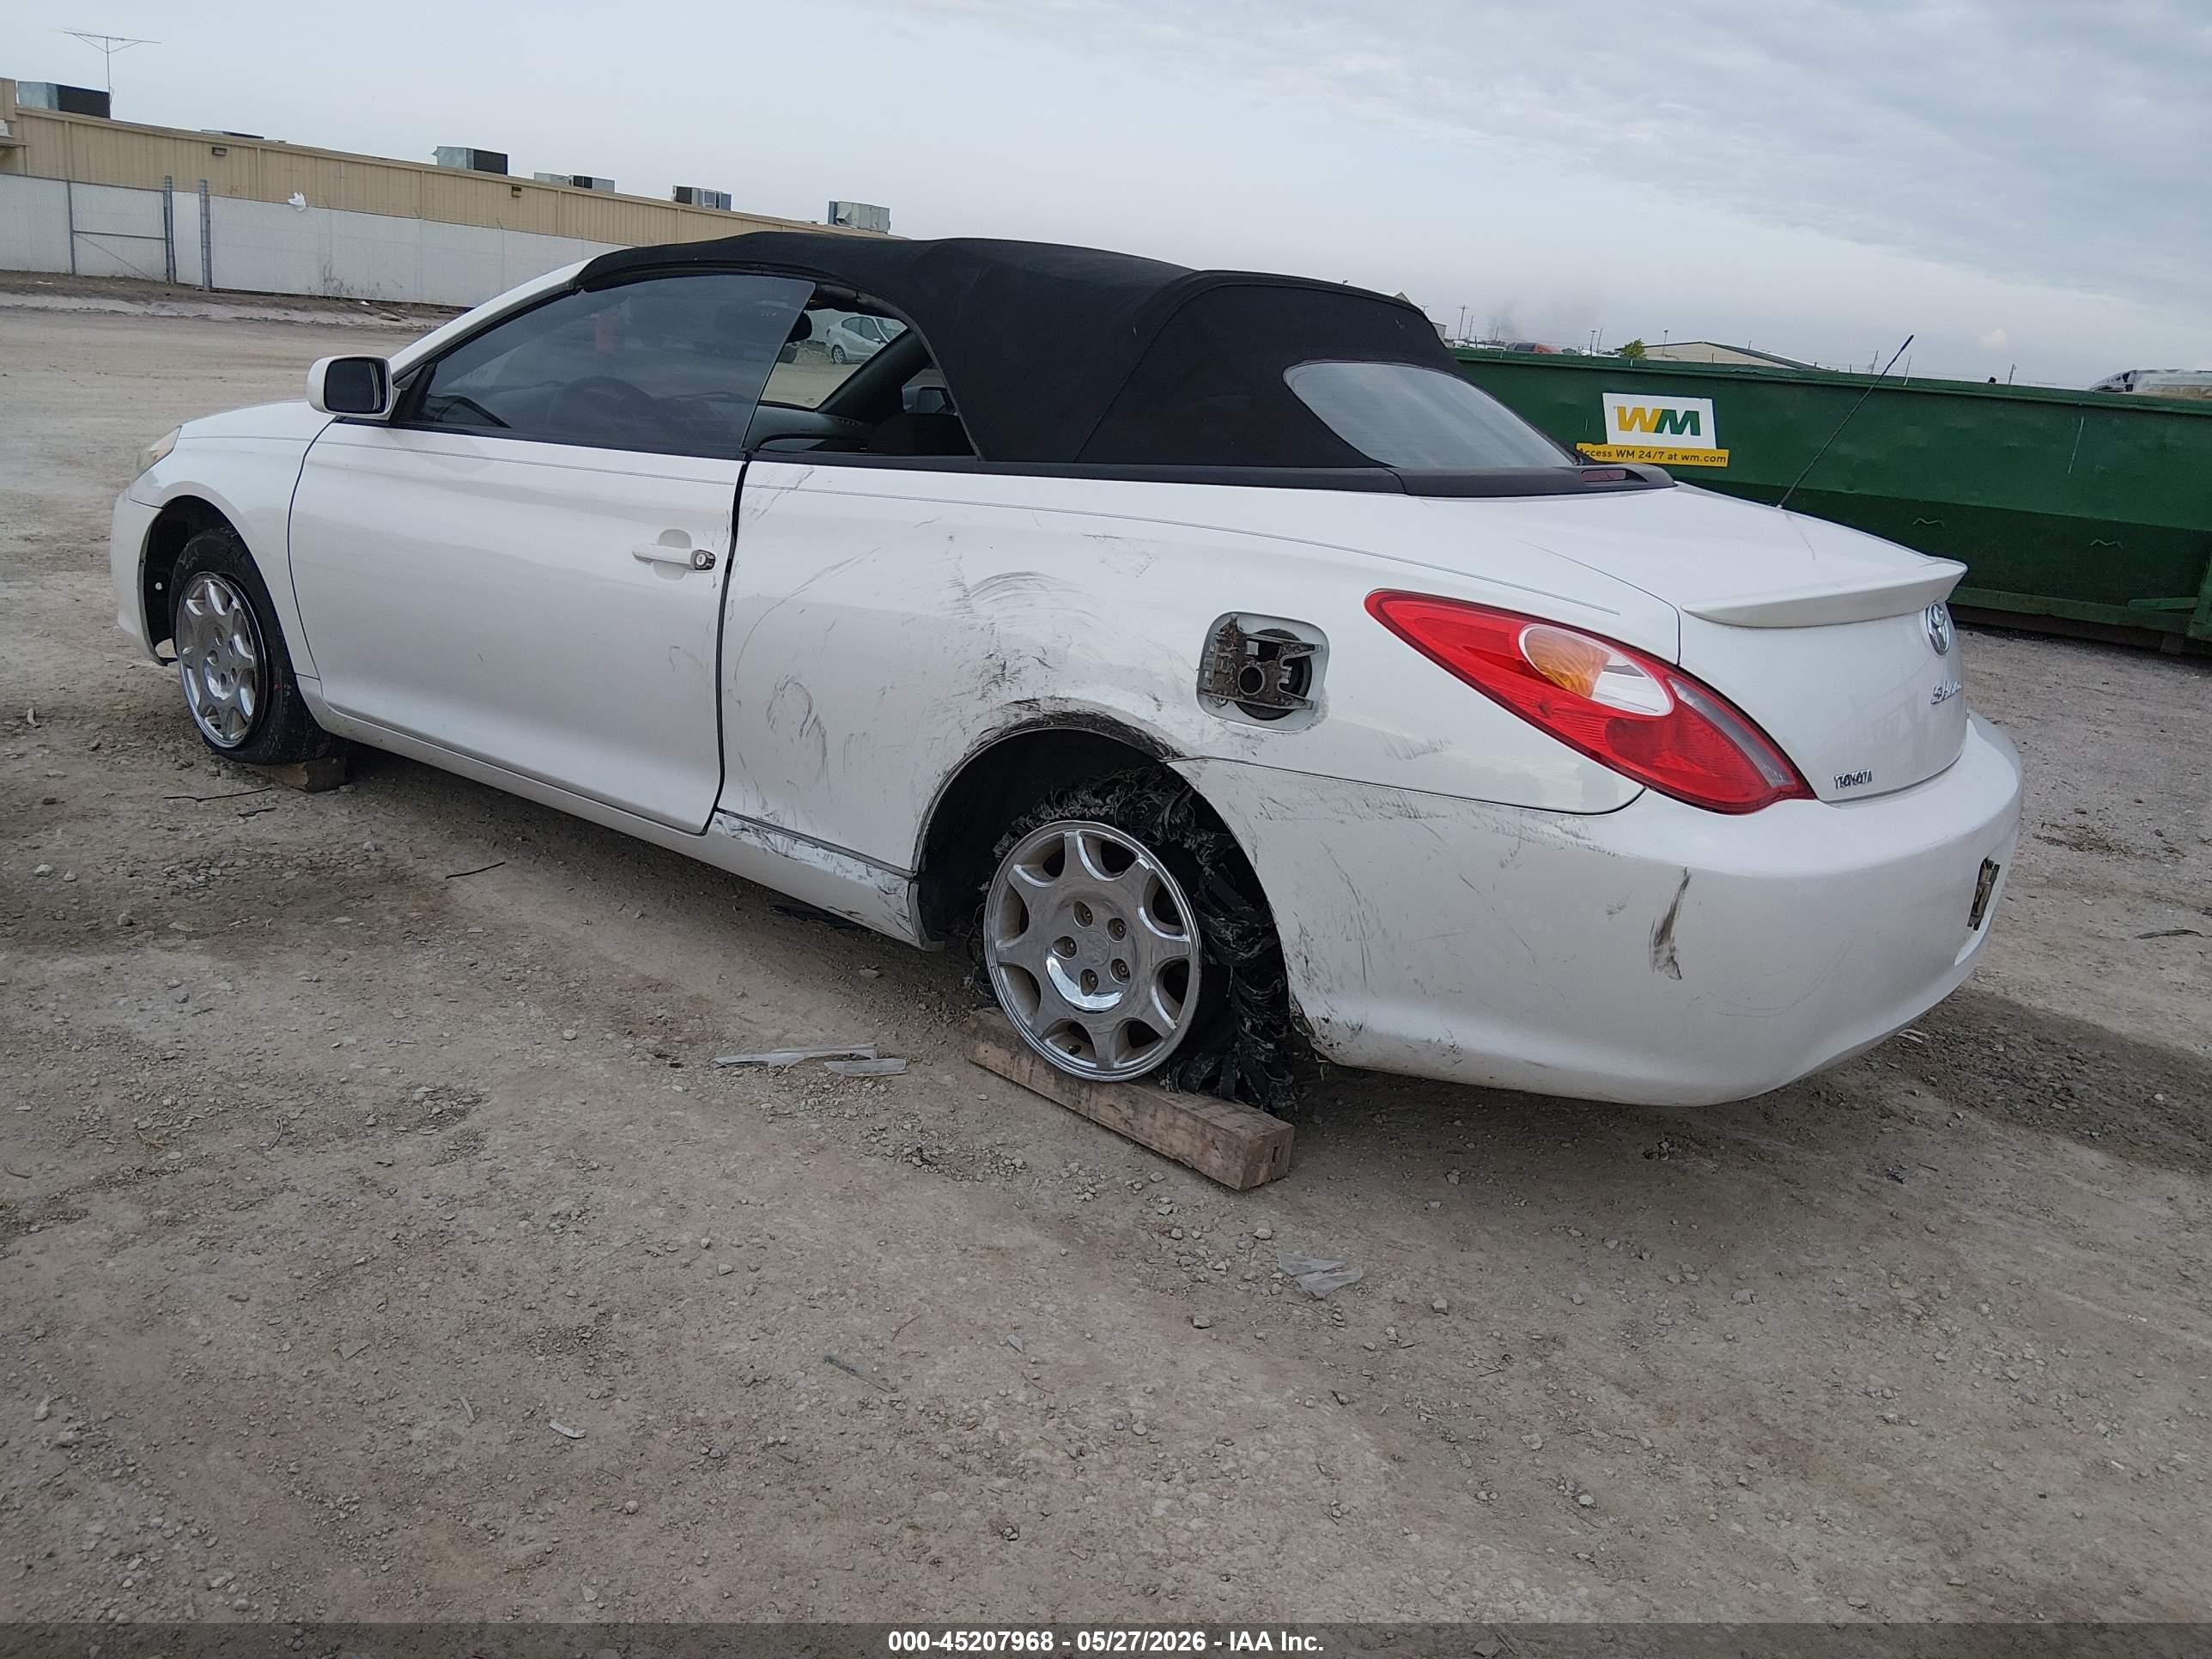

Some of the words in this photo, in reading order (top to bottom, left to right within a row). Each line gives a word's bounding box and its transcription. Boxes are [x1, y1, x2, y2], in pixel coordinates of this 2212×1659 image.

[1616, 405, 1701, 436] WM
[1615, 449, 1635, 458] WM
[1638, 451, 1665, 460] 24/7
[1680, 455, 1727, 464] wm.com
[1833, 768, 1873, 790] TOYOTA
